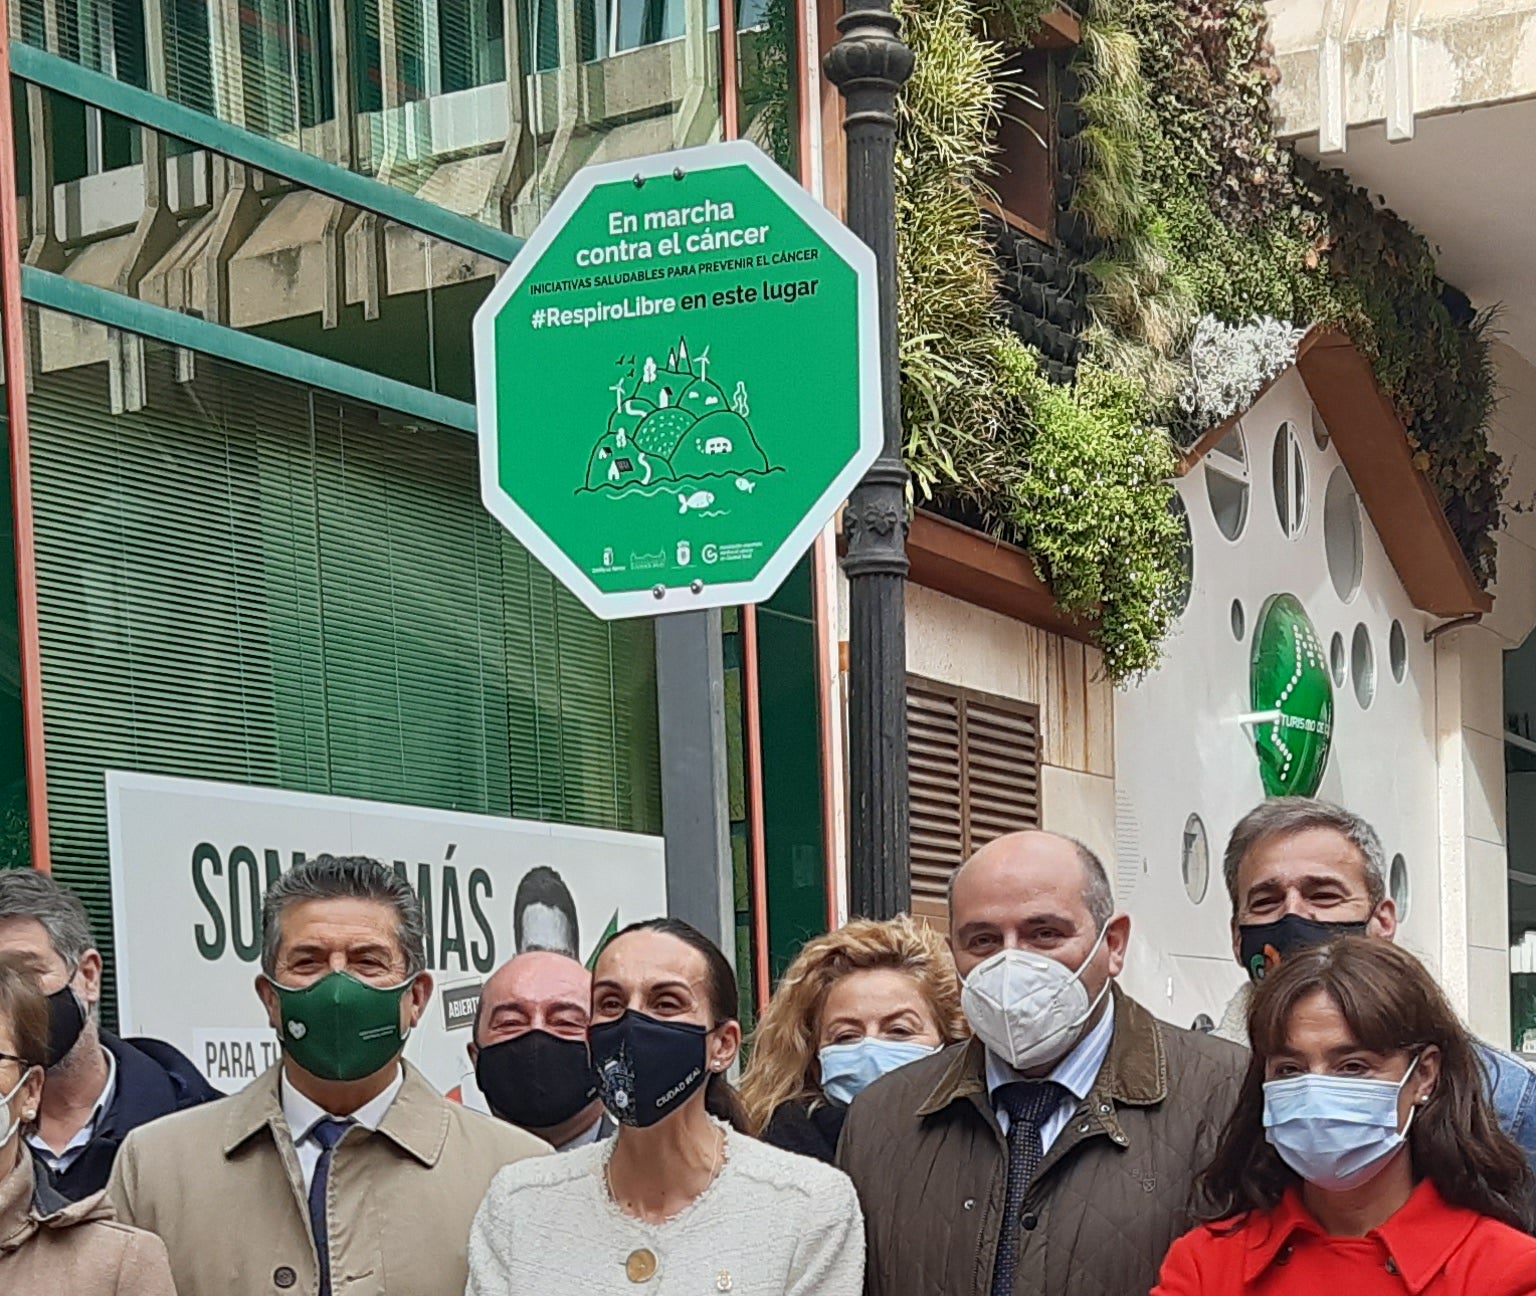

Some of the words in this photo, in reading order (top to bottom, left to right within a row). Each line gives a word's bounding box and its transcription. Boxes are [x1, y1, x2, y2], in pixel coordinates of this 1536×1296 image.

[608, 211, 638, 235] En
[643, 199, 735, 231] marcha
[575, 239, 653, 267] contra
[657, 231, 682, 256] el
[685, 225, 770, 253] cáncer
[529, 277, 592, 296] INICIATIVAS
[593, 268, 665, 288] SALUDABLES
[667, 264, 697, 279] PARA
[698, 256, 754, 275] PREVENIR
[756, 254, 770, 267] EL
[771, 248, 819, 265] CÁNCER
[531, 295, 677, 330] #RespiroLibre
[680, 292, 707, 311] en
[711, 284, 758, 308] este
[762, 279, 820, 304] lugar
[448, 995, 481, 1019] ABIERT
[205, 1041, 257, 1079] PARA
